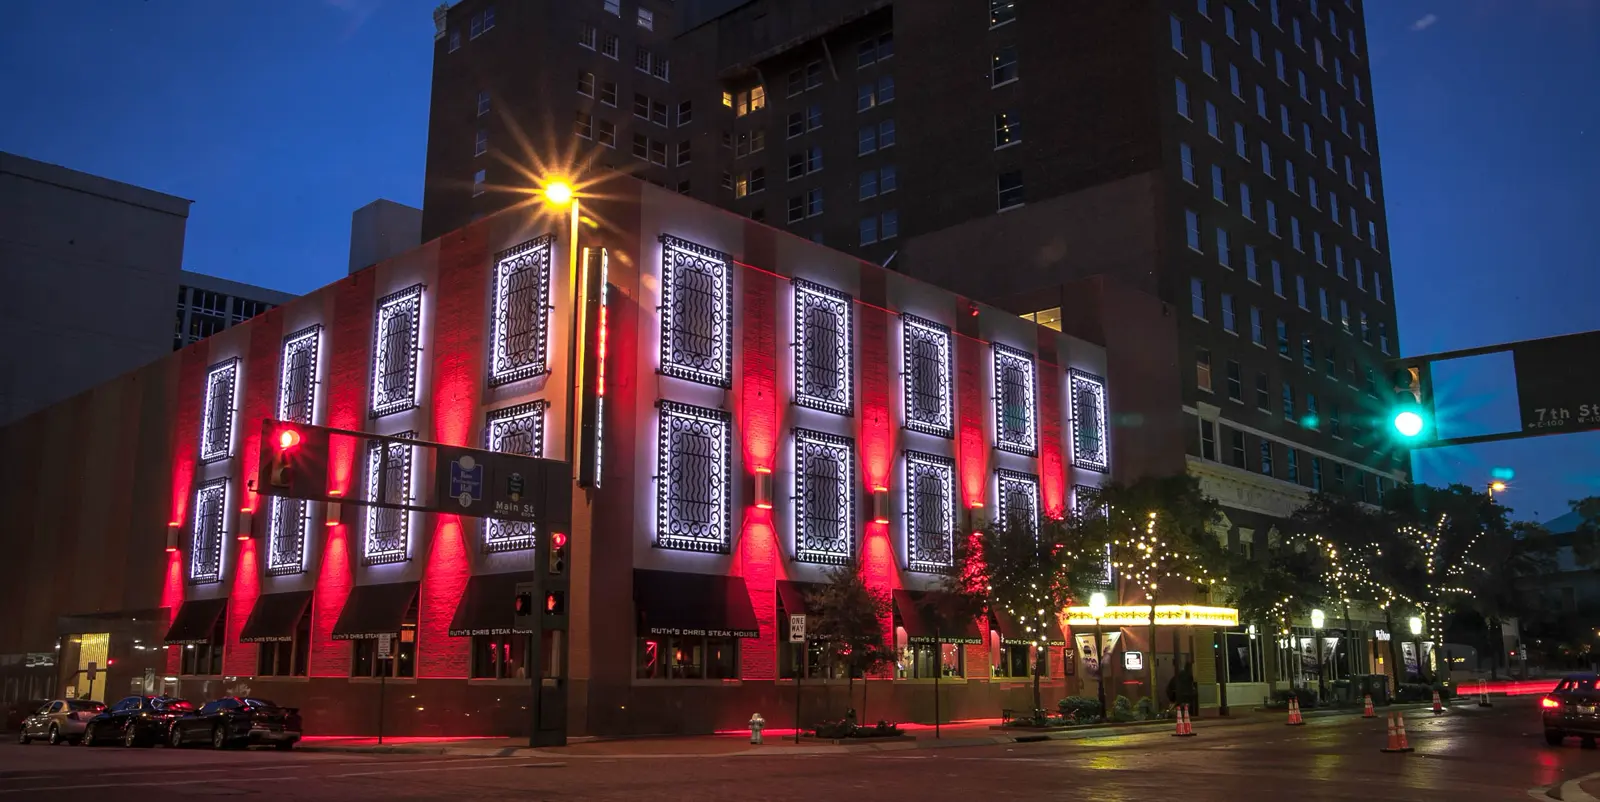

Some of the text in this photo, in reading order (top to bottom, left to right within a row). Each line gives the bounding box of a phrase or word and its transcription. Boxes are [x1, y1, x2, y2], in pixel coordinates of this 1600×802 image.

[1534, 404, 1600, 421] 7th St
[496, 501, 536, 513] Main St
[791, 617, 804, 625] ONE
[651, 627, 680, 635] RUTH'S
[791, 625, 804, 633] WAY
[350, 632, 364, 640] CHRIS
